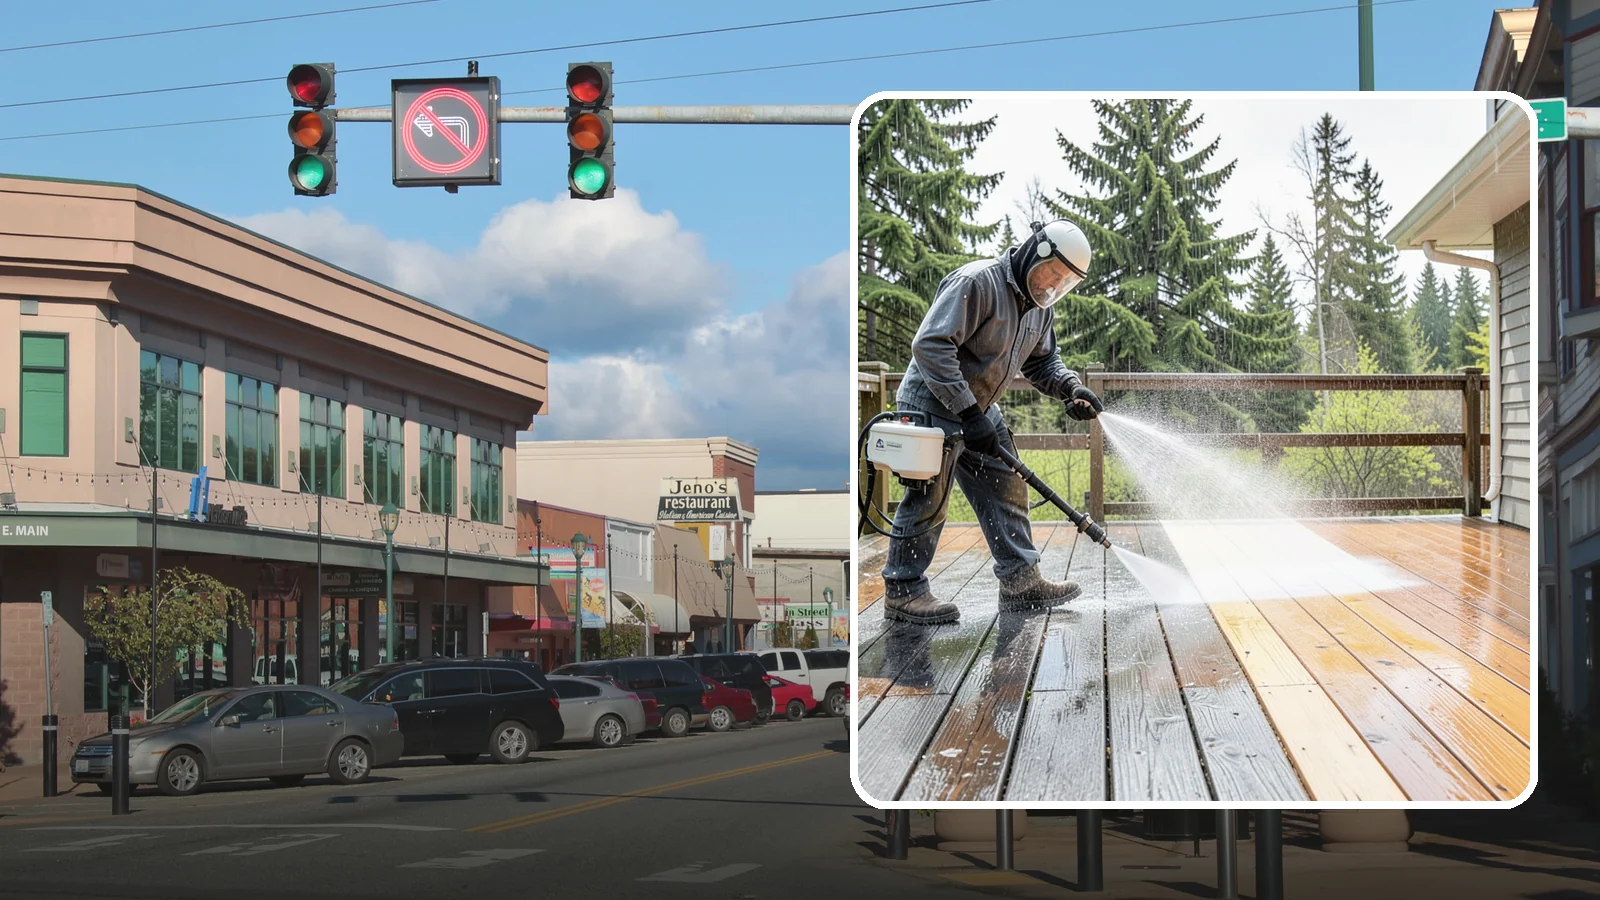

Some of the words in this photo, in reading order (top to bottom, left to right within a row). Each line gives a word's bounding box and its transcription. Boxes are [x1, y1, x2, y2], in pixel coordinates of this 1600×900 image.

[669, 480, 727, 494] Jeno's
[665, 496, 731, 509] restaurant
[658, 510, 682, 520] Italian
[686, 509, 715, 519] American
[714, 509, 738, 519] Cuisine
[2, 525, 13, 536] E.
[15, 525, 49, 537] MAIN
[797, 607, 829, 617] Street
[790, 619, 823, 627] lass
